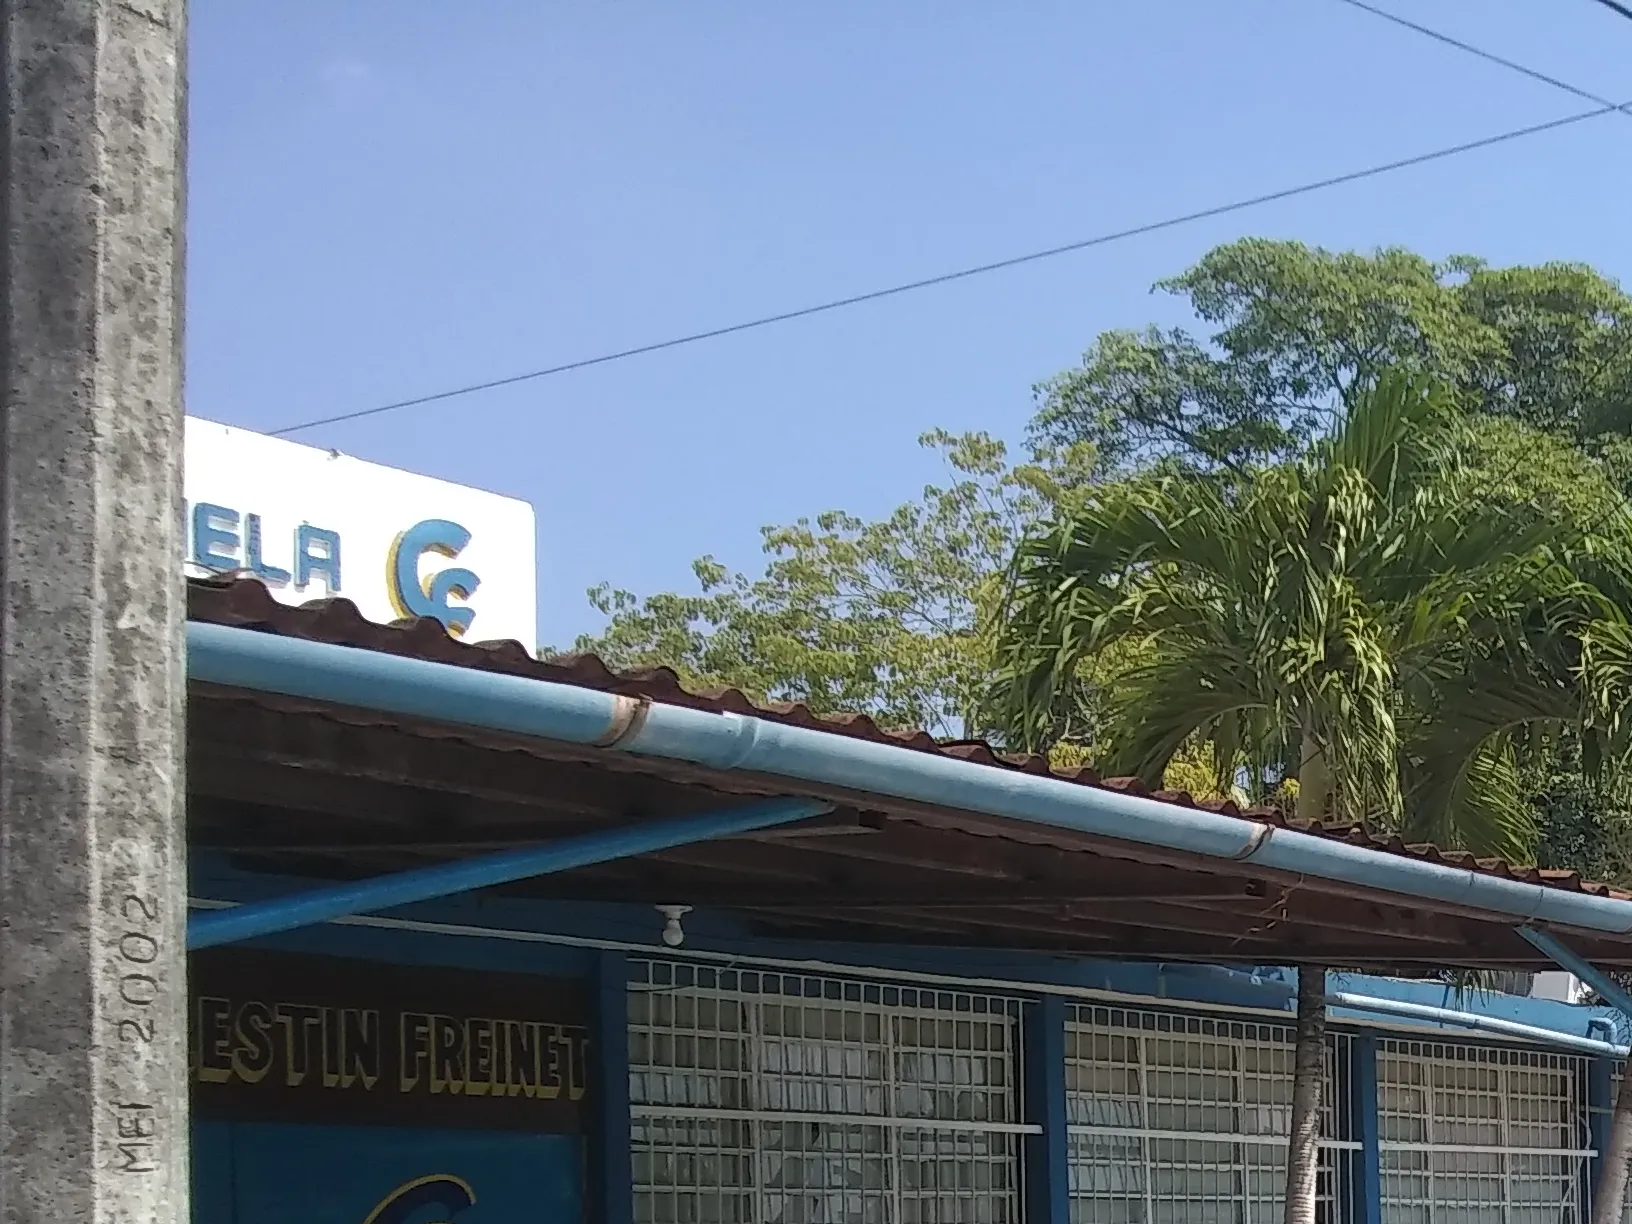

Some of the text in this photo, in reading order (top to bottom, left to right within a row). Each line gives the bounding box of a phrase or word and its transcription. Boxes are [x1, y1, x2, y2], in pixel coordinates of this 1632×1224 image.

[184, 502, 341, 598] ELA
[118, 894, 158, 1043] 2002
[189, 997, 589, 1100] ESTIN FREINET
